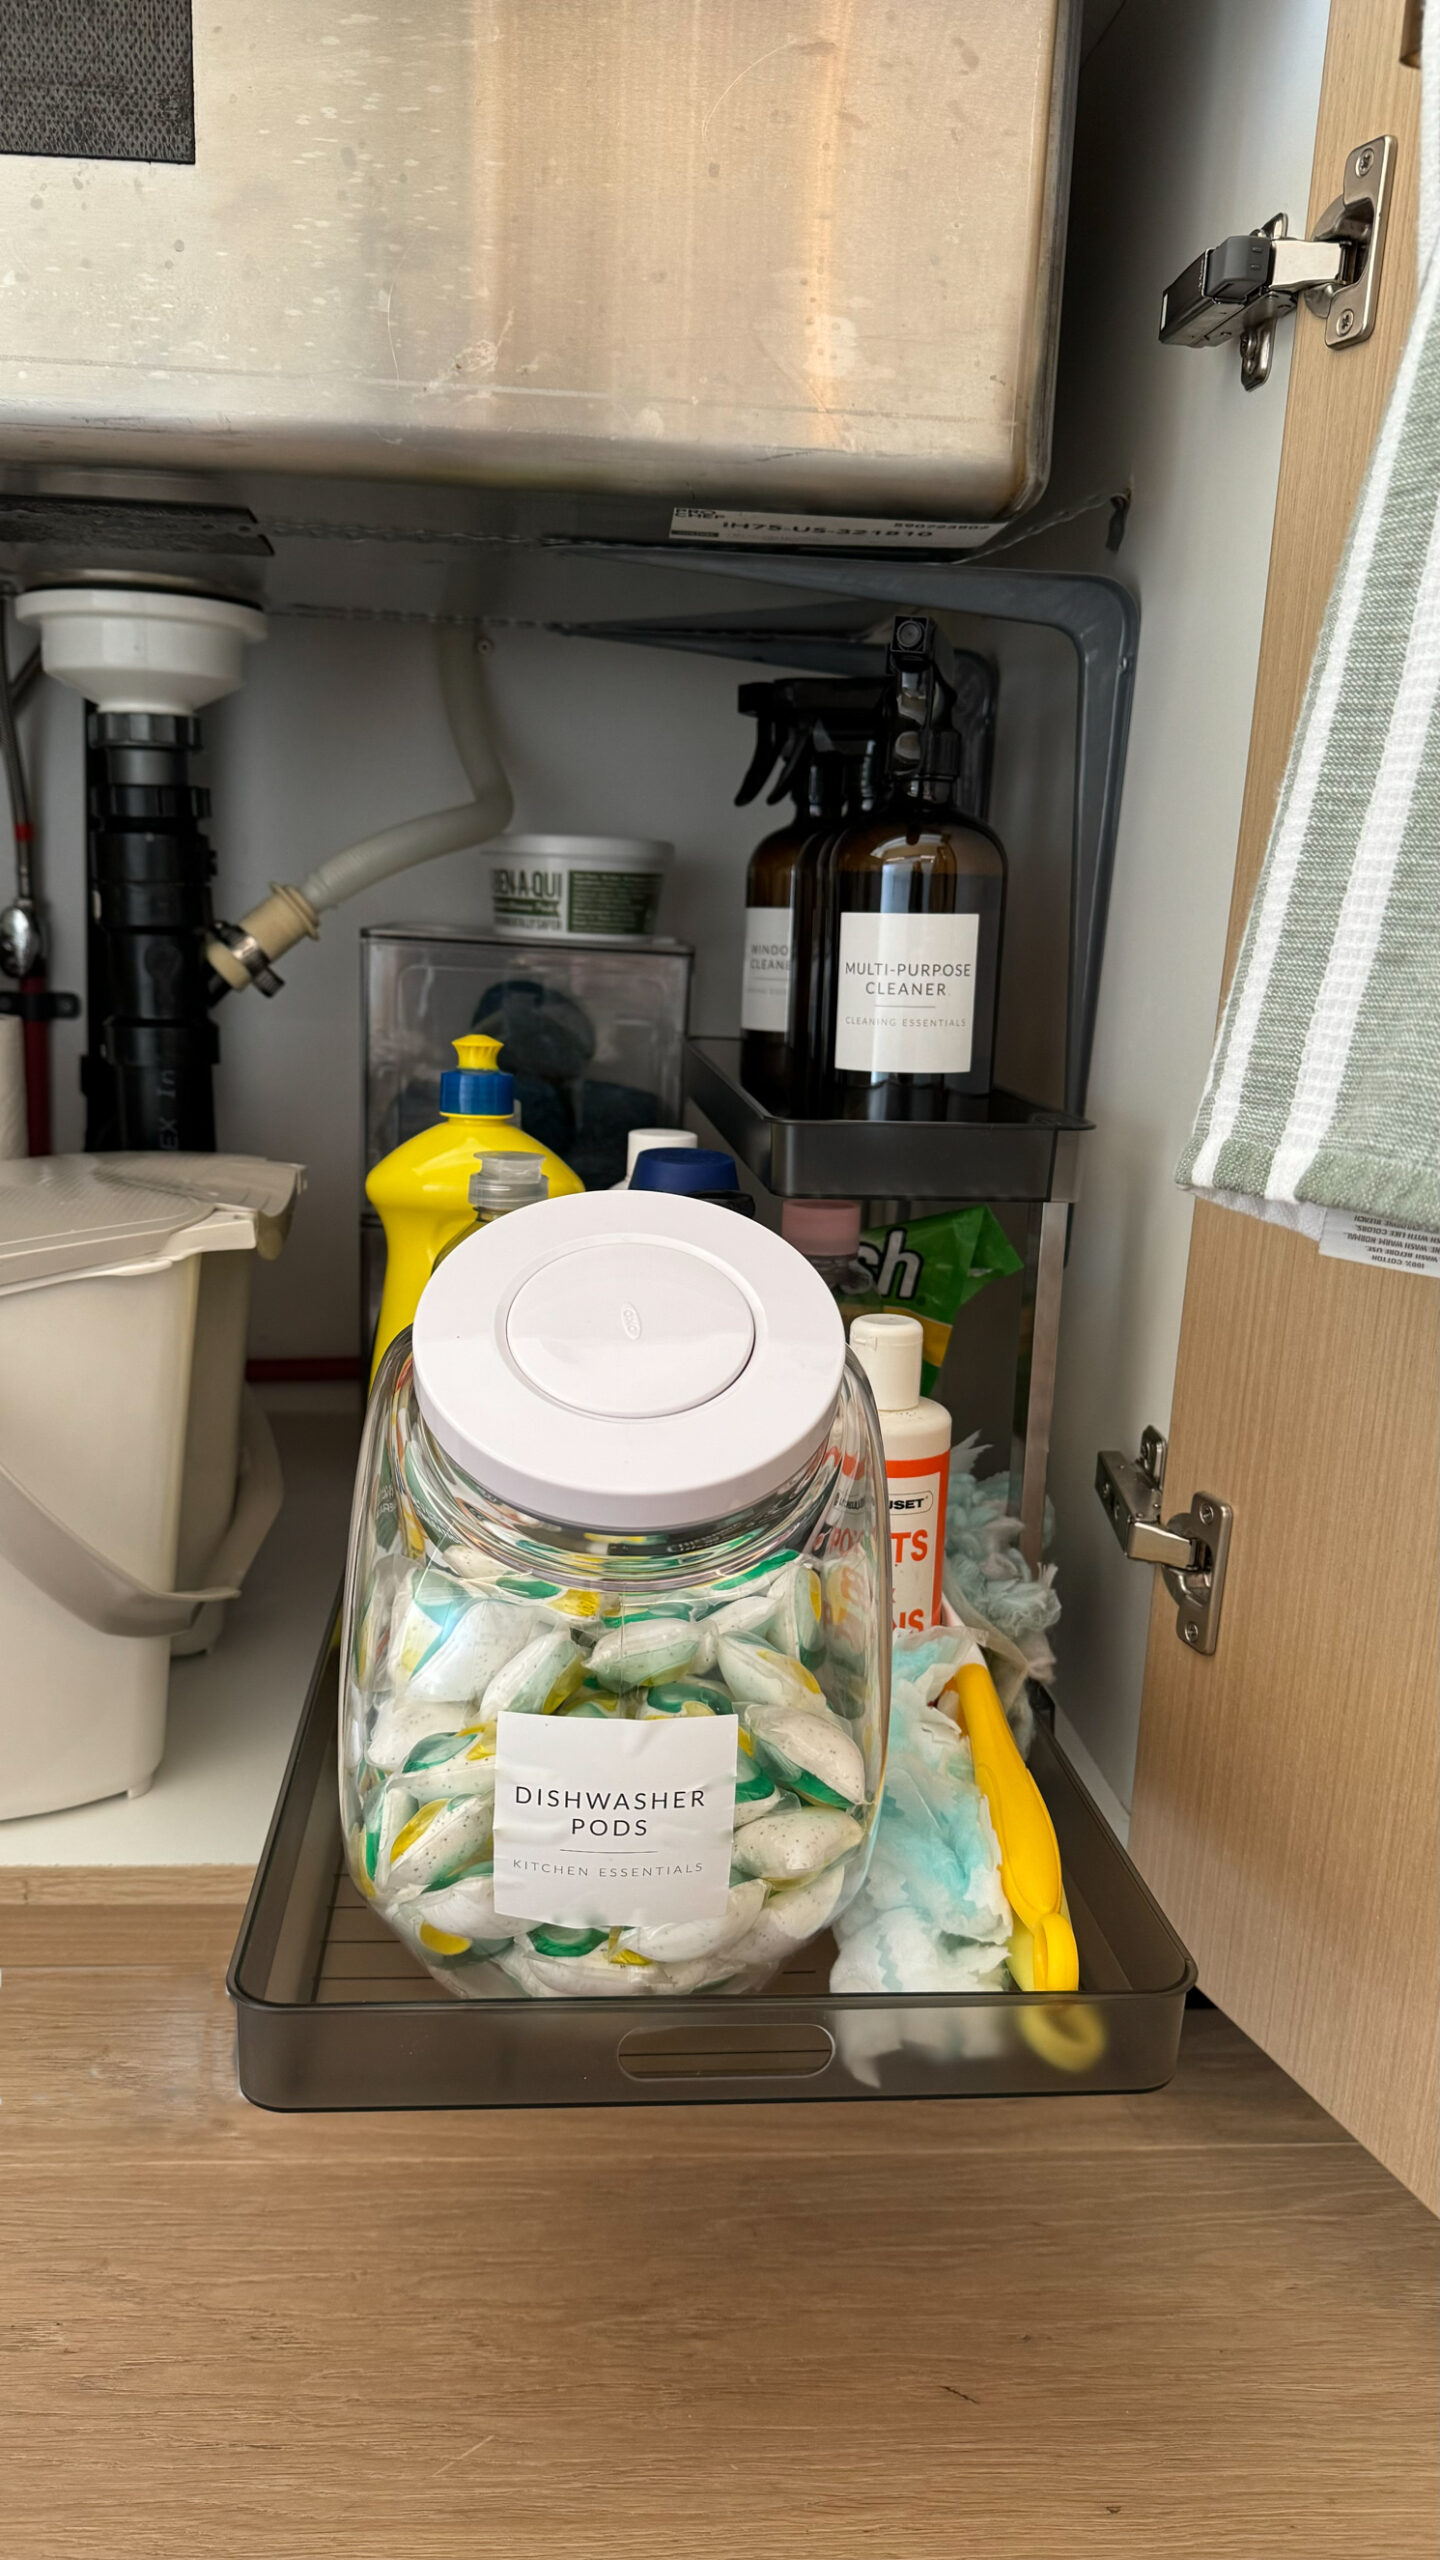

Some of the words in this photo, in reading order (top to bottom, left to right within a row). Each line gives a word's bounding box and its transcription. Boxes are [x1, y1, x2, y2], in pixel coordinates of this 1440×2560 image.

[750, 943, 788, 956] WINDO
[845, 962, 971, 977] MULTI-PURPOSE
[865, 982, 946, 997] CLEANER
[845, 1016, 897, 1027] CLEANING
[902, 1017, 967, 1028] ESSENTIALS
[1378, 1238, 1403, 1249] WARM
[1404, 1242, 1428, 1252] WASH
[1384, 1248, 1413, 1259] BEFORE
[1415, 1253, 1438, 1263] WASH
[1371, 1255, 1403, 1266] COTTON
[1405, 1261, 1425, 1270] 100%
[515, 1785, 705, 1810] DISHWASHER
[571, 1818, 648, 1837] PODS
[513, 1859, 589, 1877] KITCHEN
[599, 1862, 703, 1877] ESSENTIALS
